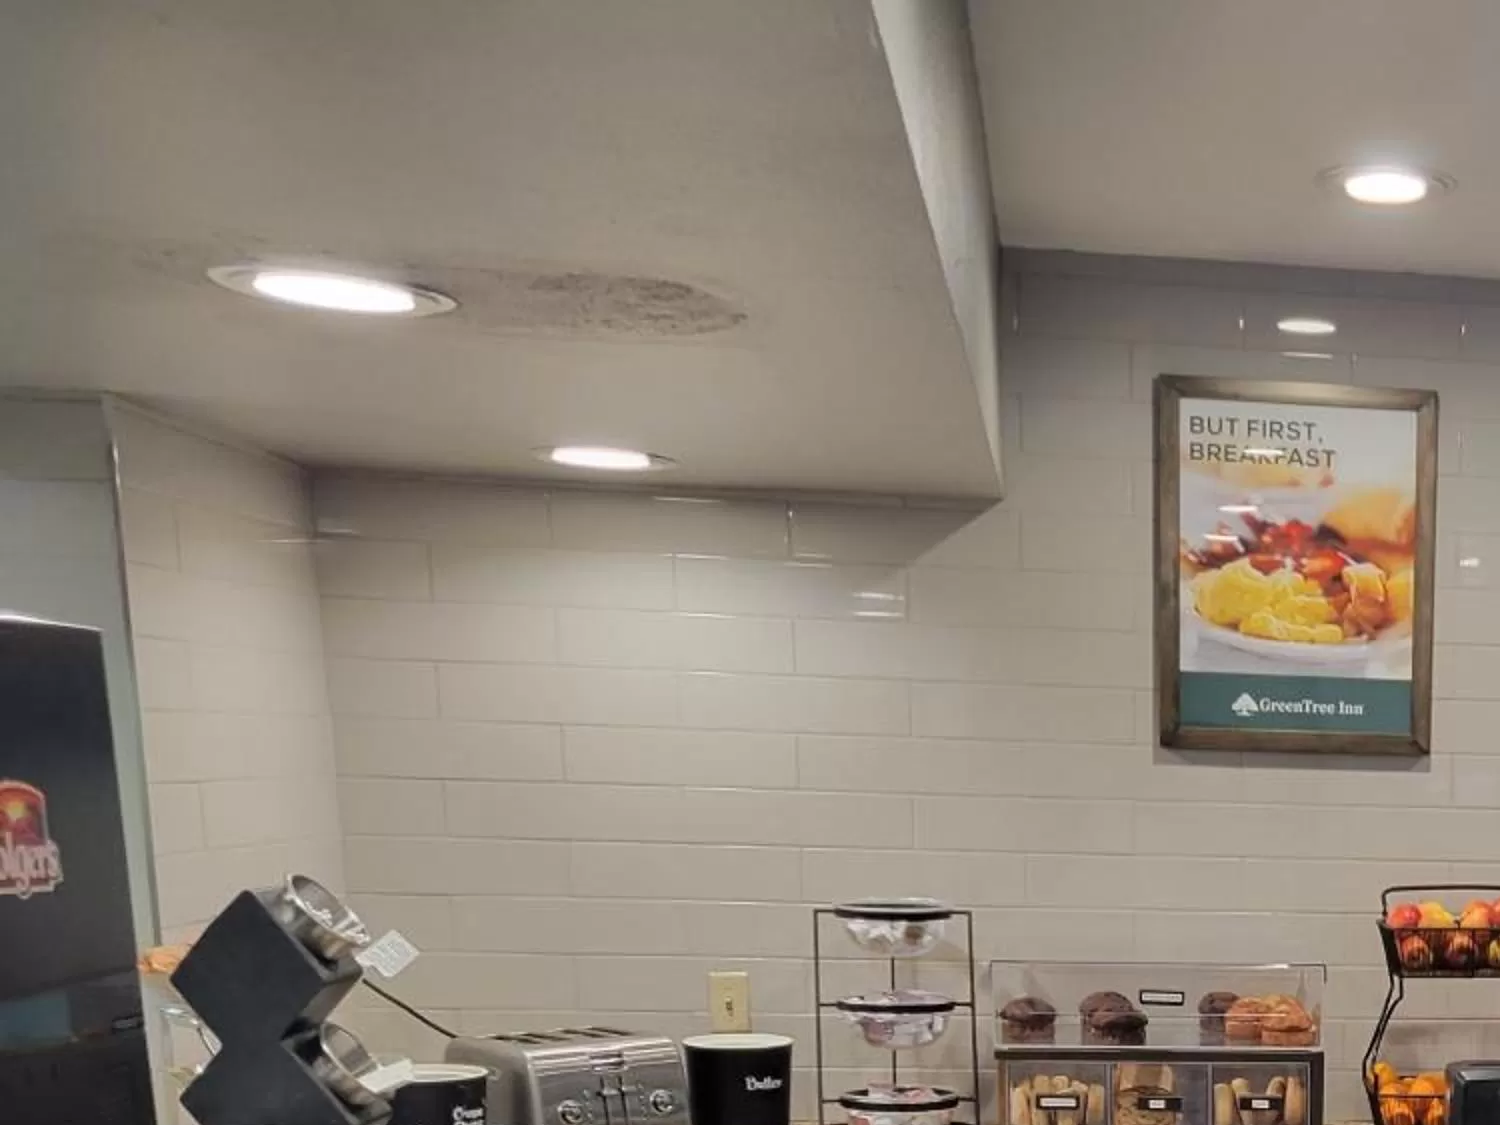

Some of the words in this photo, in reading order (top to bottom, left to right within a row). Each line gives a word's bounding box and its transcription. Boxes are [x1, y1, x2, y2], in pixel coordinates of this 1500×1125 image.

[1189, 415, 1240, 437] BUT
[1247, 418, 1323, 444] FIRST,
[1259, 697, 1335, 714] GreenTree
[1338, 700, 1364, 715] Inn
